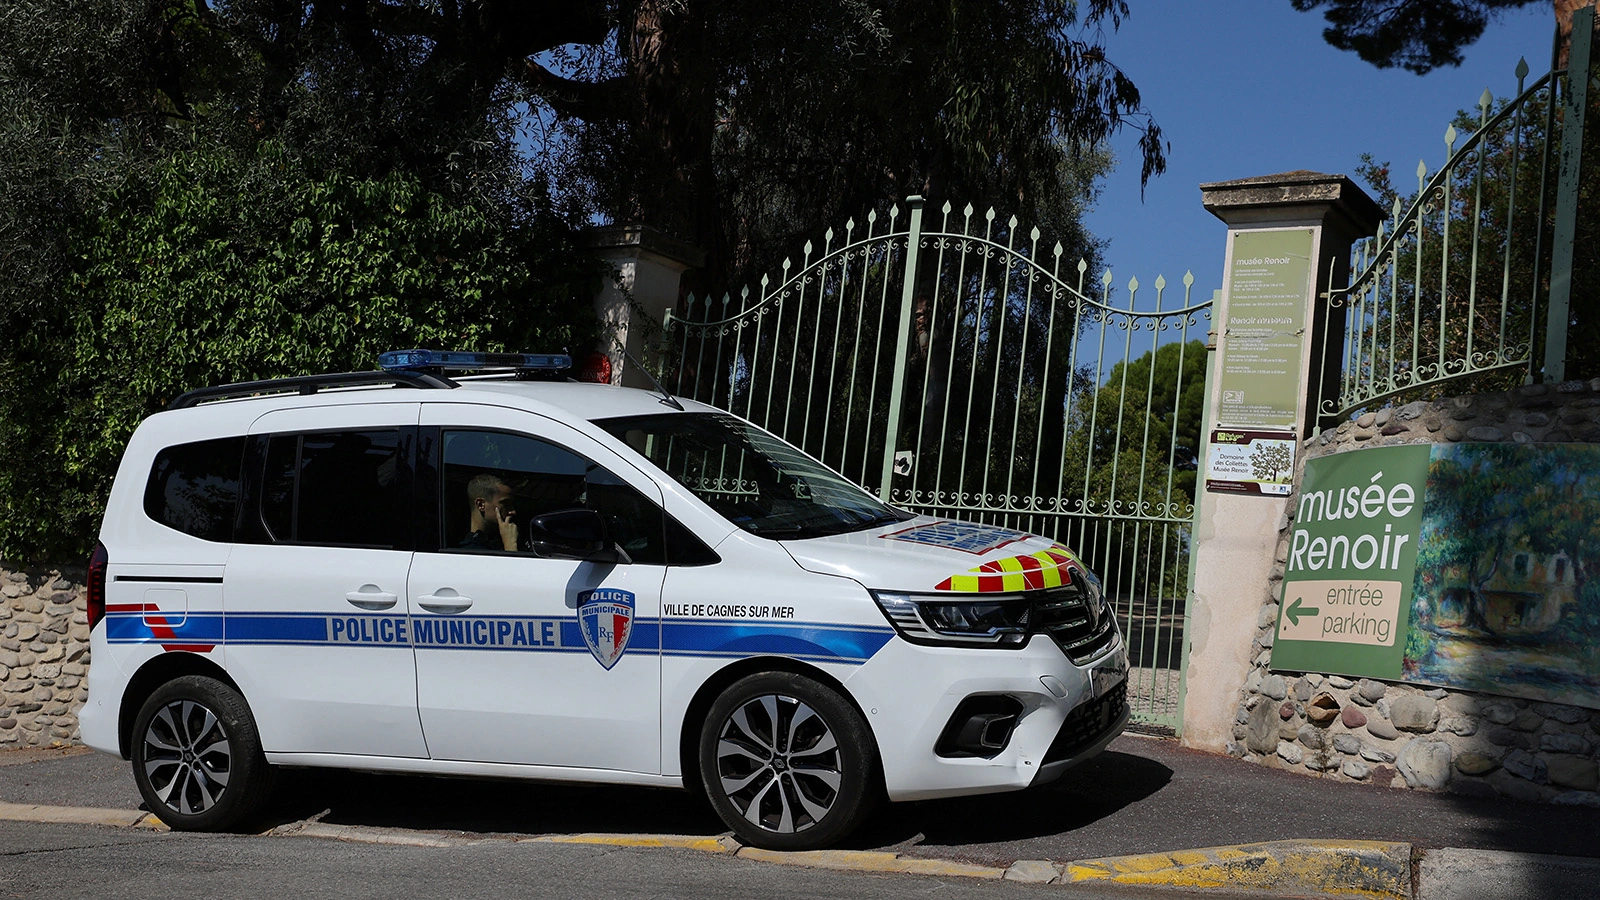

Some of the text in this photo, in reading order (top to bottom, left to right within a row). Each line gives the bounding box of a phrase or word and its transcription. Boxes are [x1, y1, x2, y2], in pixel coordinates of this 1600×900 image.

[1236, 257, 1290, 266] musée Renoir
[1231, 317, 1256, 325] Renoir
[1297, 471, 1415, 523] musée
[1288, 523, 1409, 571] Renoir
[582, 591, 630, 604] POLICE
[1327, 583, 1383, 606] entrée
[582, 605, 630, 617] MUNICIPALE
[664, 604, 794, 618] VILLE DE CAGNES SUR MER
[332, 618, 554, 646] POLICE MUNICIPALE
[599, 627, 614, 642] RF
[1322, 612, 1390, 642] parking
